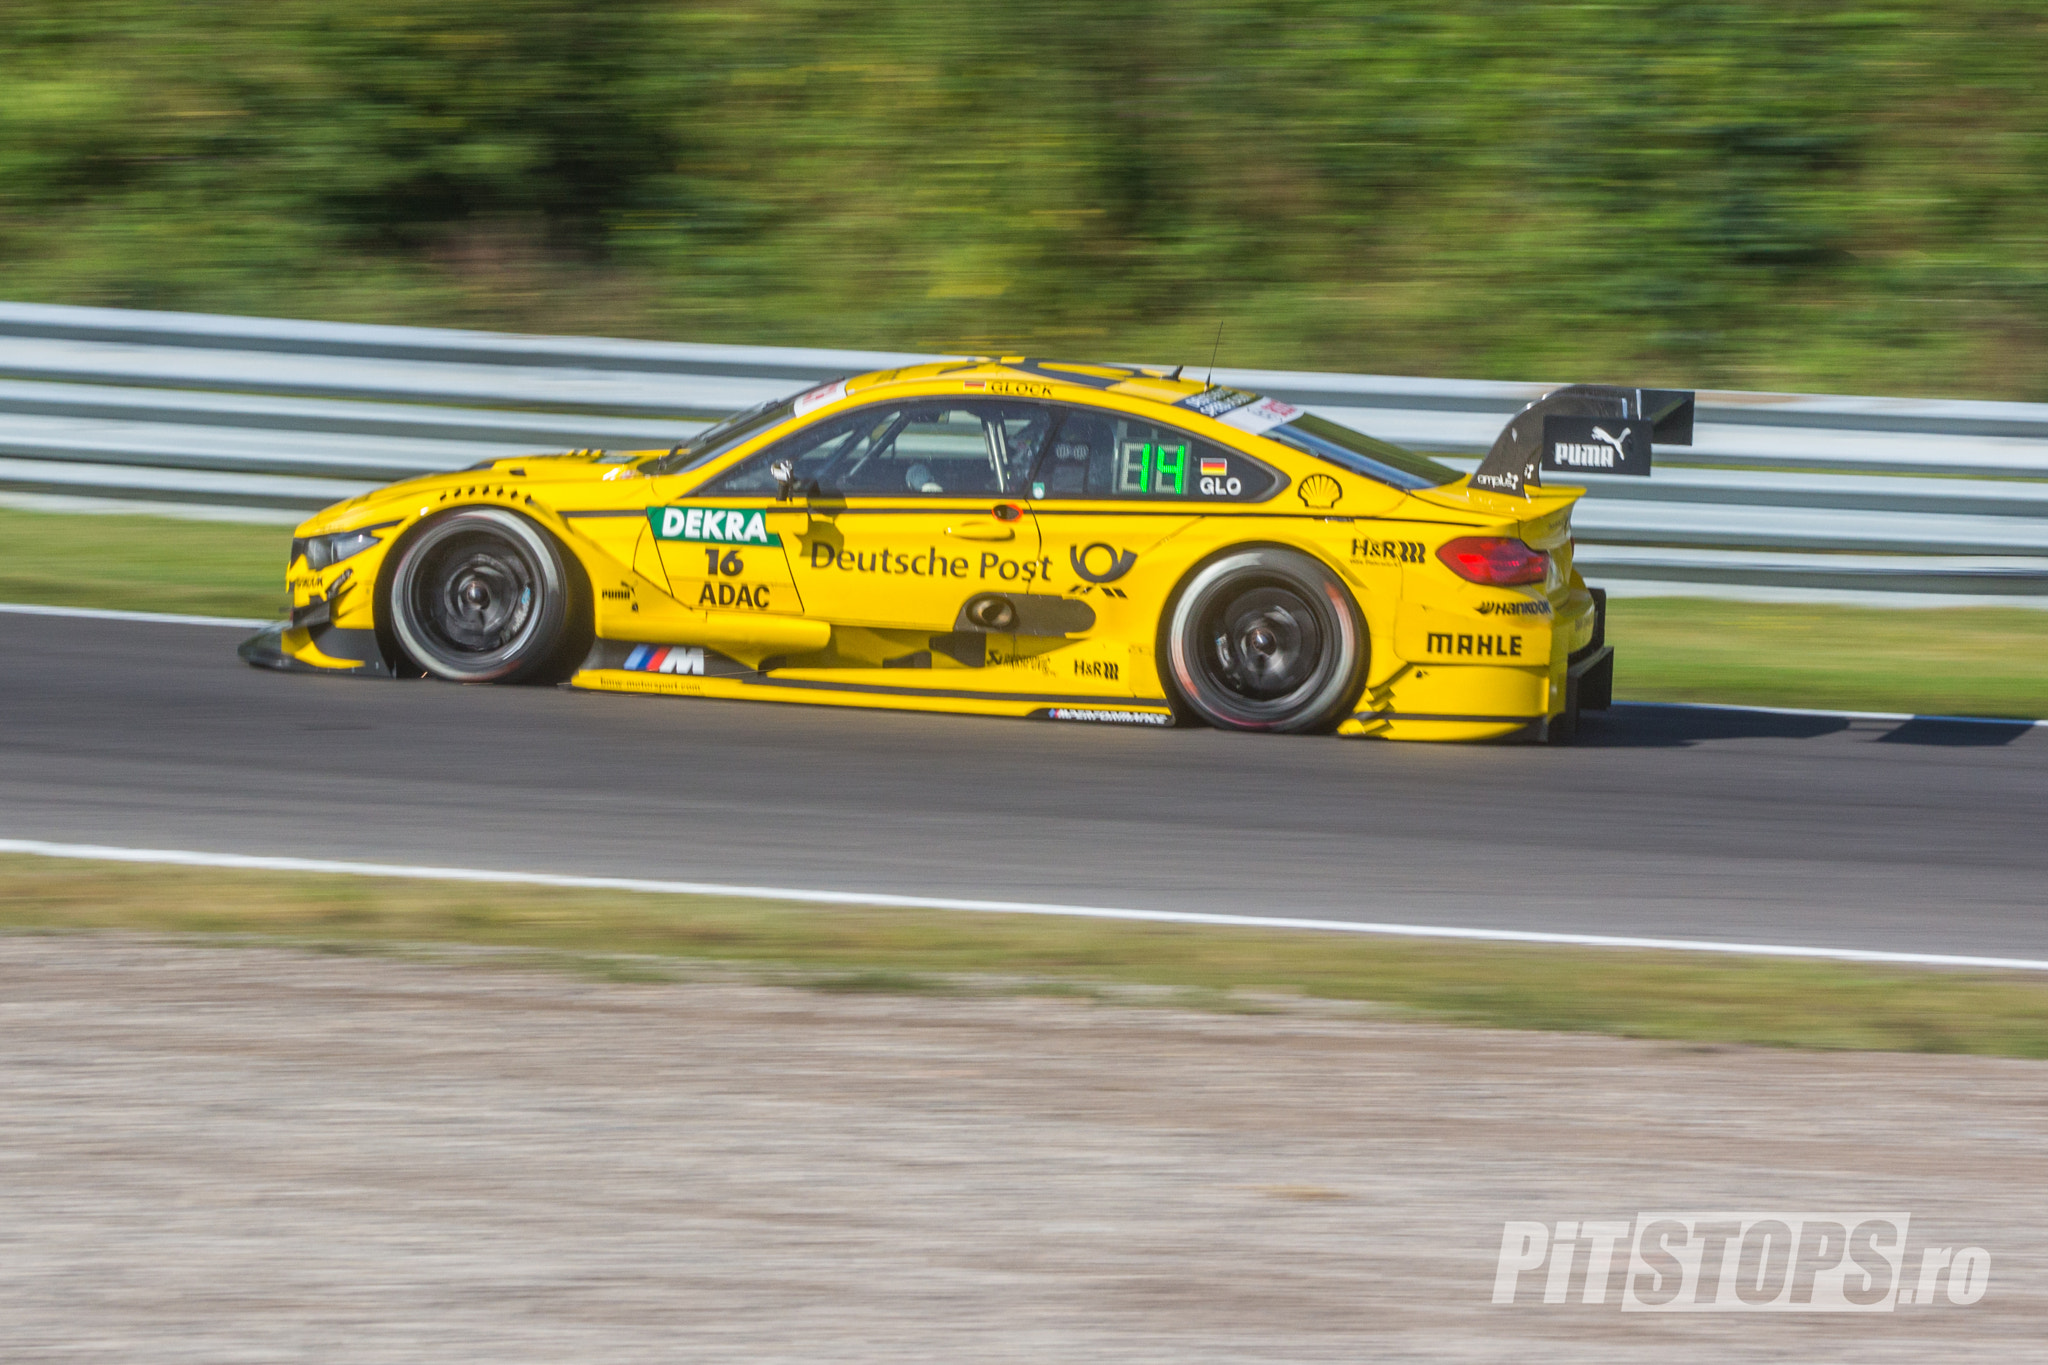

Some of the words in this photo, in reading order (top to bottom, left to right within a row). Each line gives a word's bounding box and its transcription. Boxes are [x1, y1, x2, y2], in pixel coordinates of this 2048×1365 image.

[990, 380, 1054, 397] GLOCK
[1554, 442, 1614, 468] PUMA
[1140, 443, 1186, 495] 14
[1200, 476, 1242, 496] GLO
[661, 507, 768, 543] DEKRA
[810, 540, 969, 579] Deutsche
[979, 550, 1053, 582] Post
[1352, 538, 1396, 559] H&R
[705, 548, 744, 577] 16
[698, 581, 770, 609] ADAC
[1427, 632, 1523, 657] MAHLE
[1074, 659, 1102, 678] H&R
